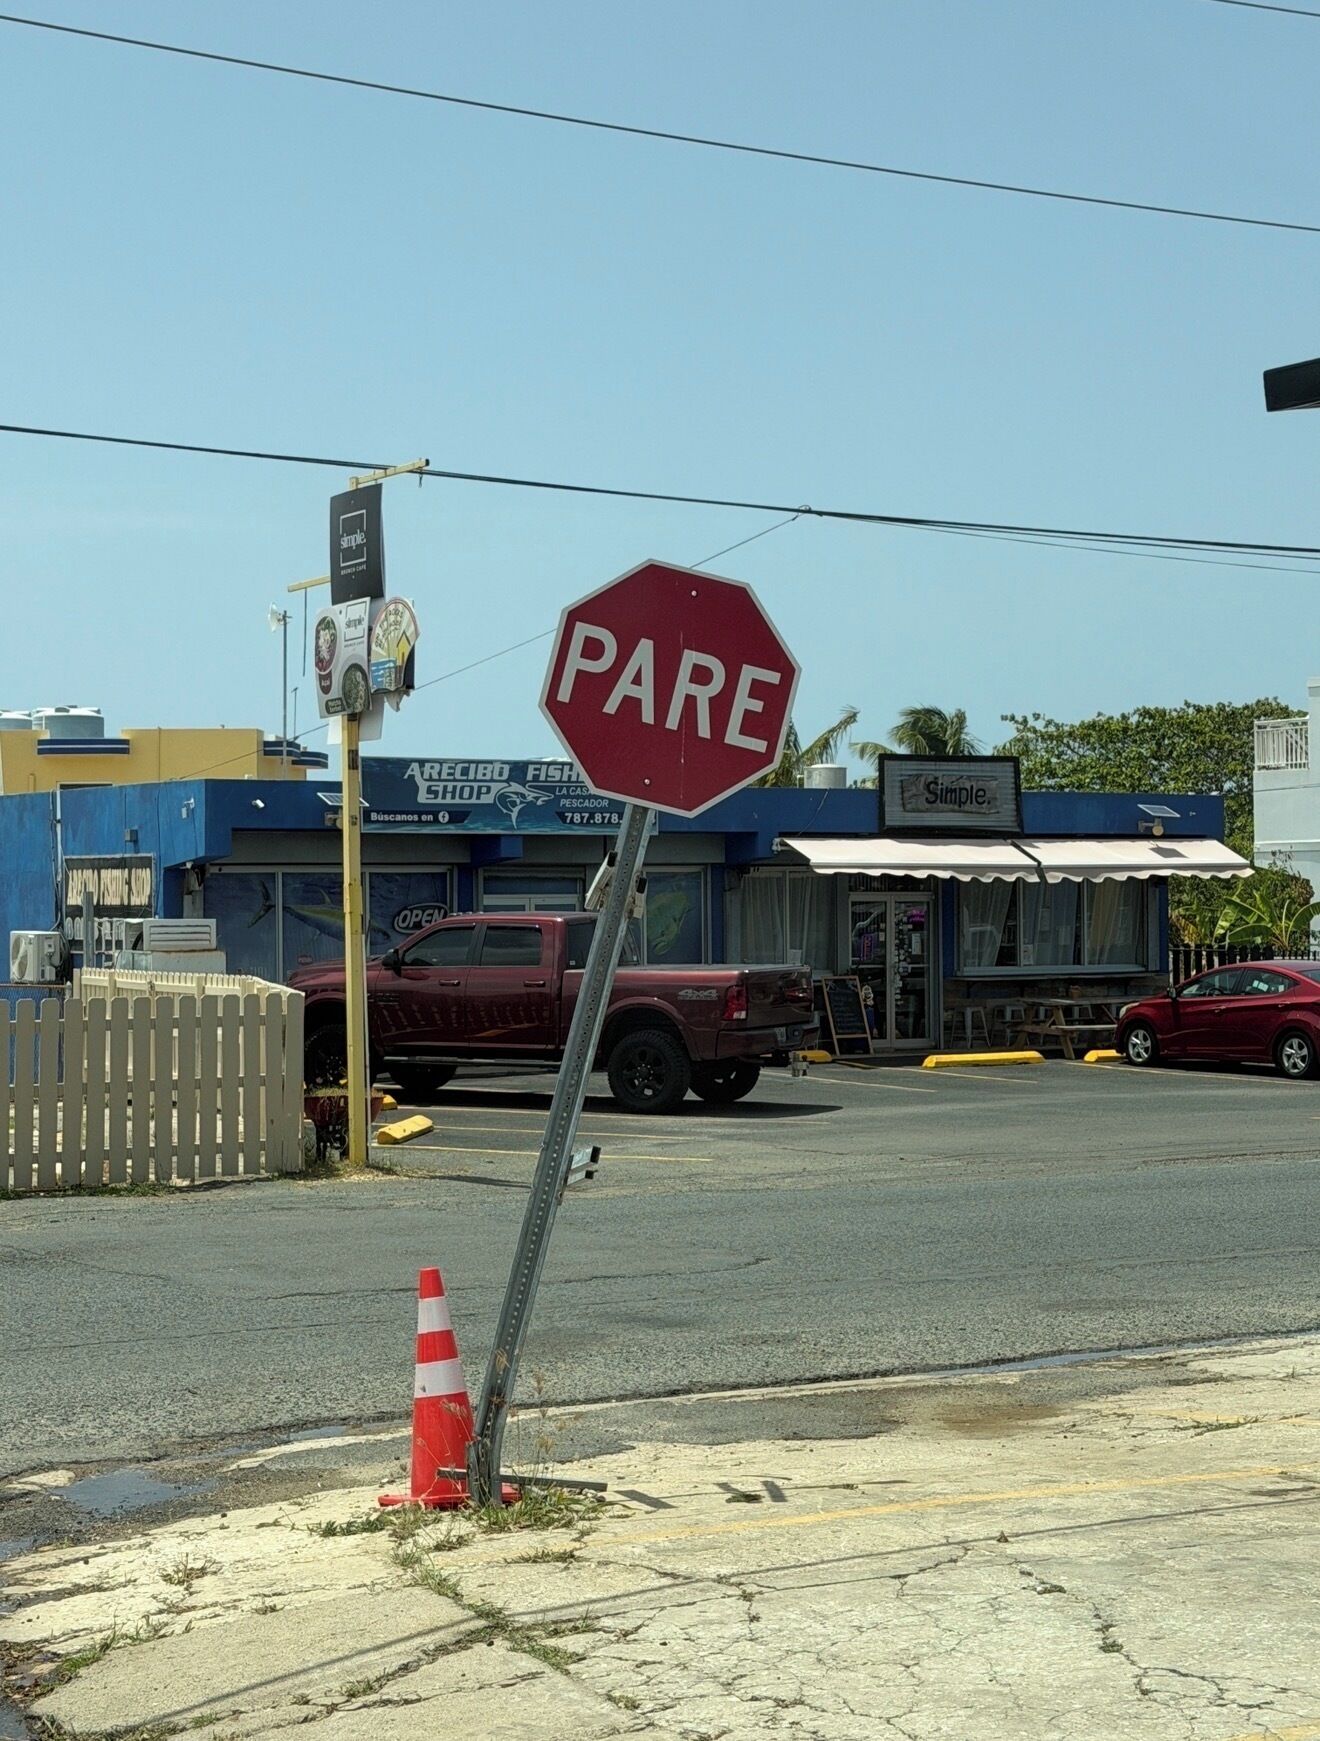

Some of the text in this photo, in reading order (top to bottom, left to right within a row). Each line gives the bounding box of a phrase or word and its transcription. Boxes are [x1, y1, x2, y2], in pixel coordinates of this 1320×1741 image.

[556, 620, 782, 754] PARE
[403, 762, 584, 782] ARECIBO FISH
[425, 785, 492, 801] SHOP
[555, 786, 568, 795] LA
[925, 779, 991, 809] Simple.
[560, 798, 609, 808] PESCADOR
[370, 811, 419, 822] Búscanos
[421, 813, 434, 822] en
[564, 812, 656, 824] 787.878.
[398, 908, 444, 928] OPEN
